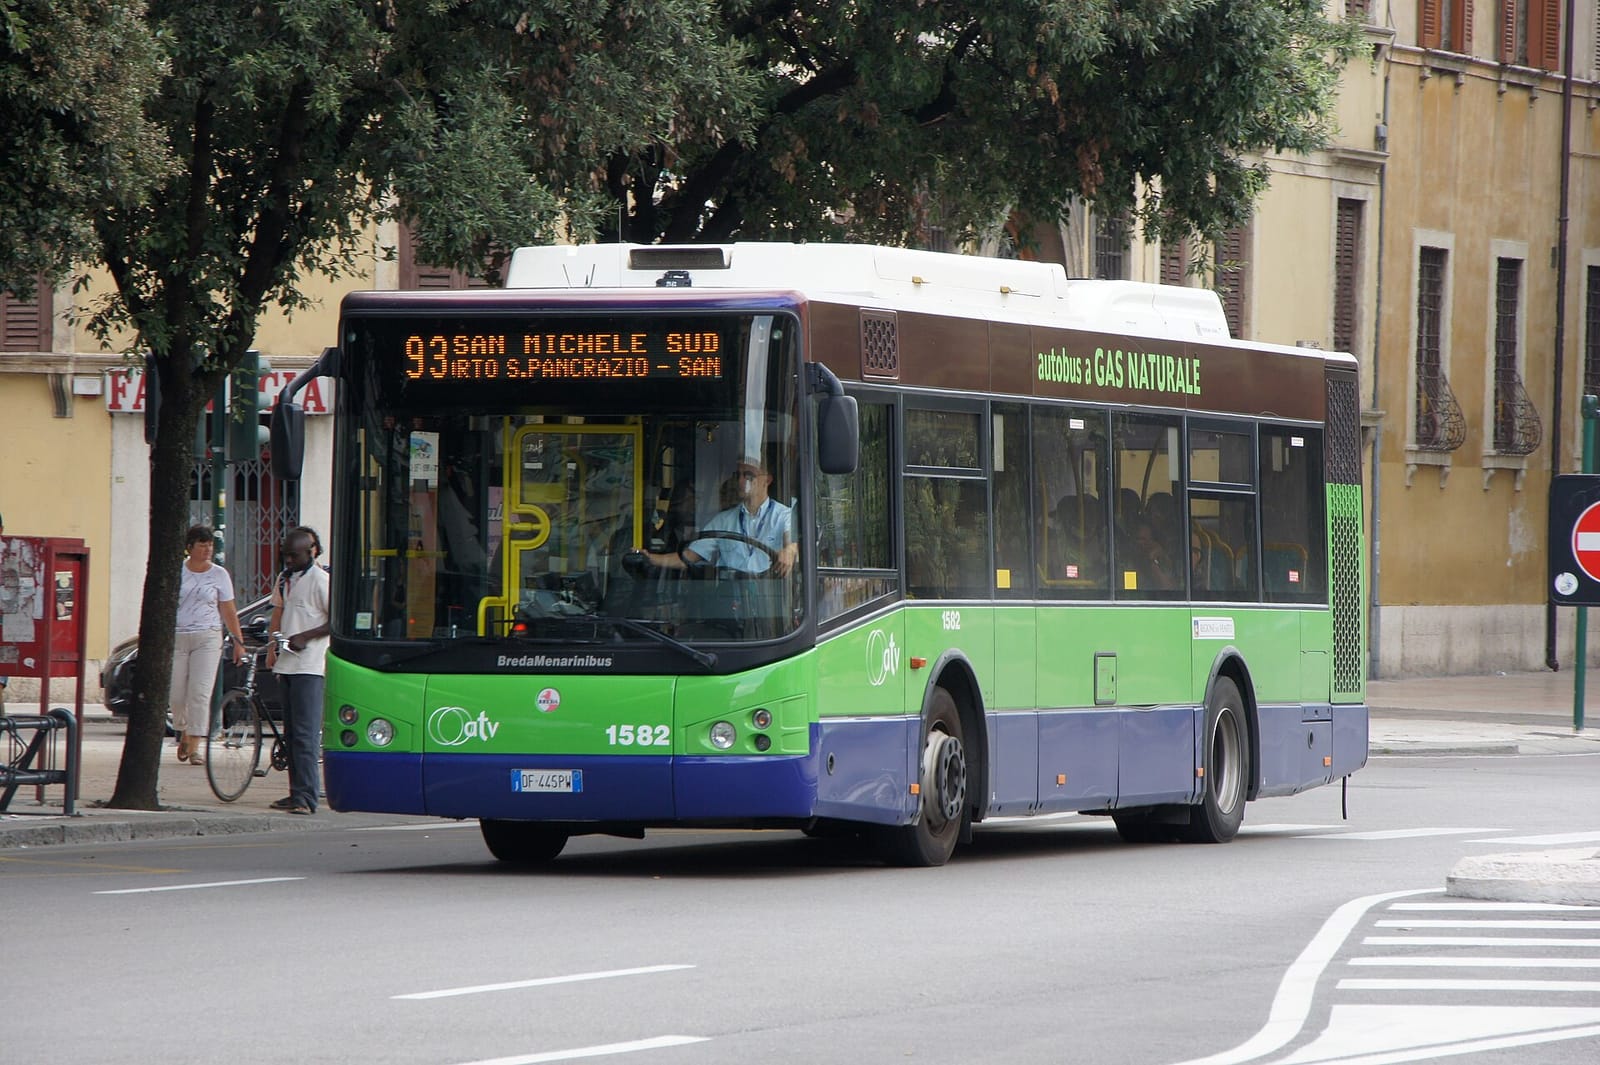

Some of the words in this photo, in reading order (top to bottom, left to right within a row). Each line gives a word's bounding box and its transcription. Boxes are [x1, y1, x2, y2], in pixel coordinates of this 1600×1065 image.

[452, 335, 505, 355] SAN
[523, 333, 648, 354] MICHELE
[666, 332, 720, 353] SUD
[405, 335, 448, 379] 93
[506, 357, 649, 378] S.PANCRAZIO
[678, 356, 722, 377] SAN
[1038, 347, 1082, 385] autobus
[1085, 357, 1092, 386] a
[1094, 347, 1124, 389] GAS
[1127, 351, 1201, 395] NATURALE
[941, 610, 961, 631] 1582
[497, 655, 613, 667] BredaMenarinibus
[464, 711, 499, 742] atv
[606, 725, 670, 746] 1582
